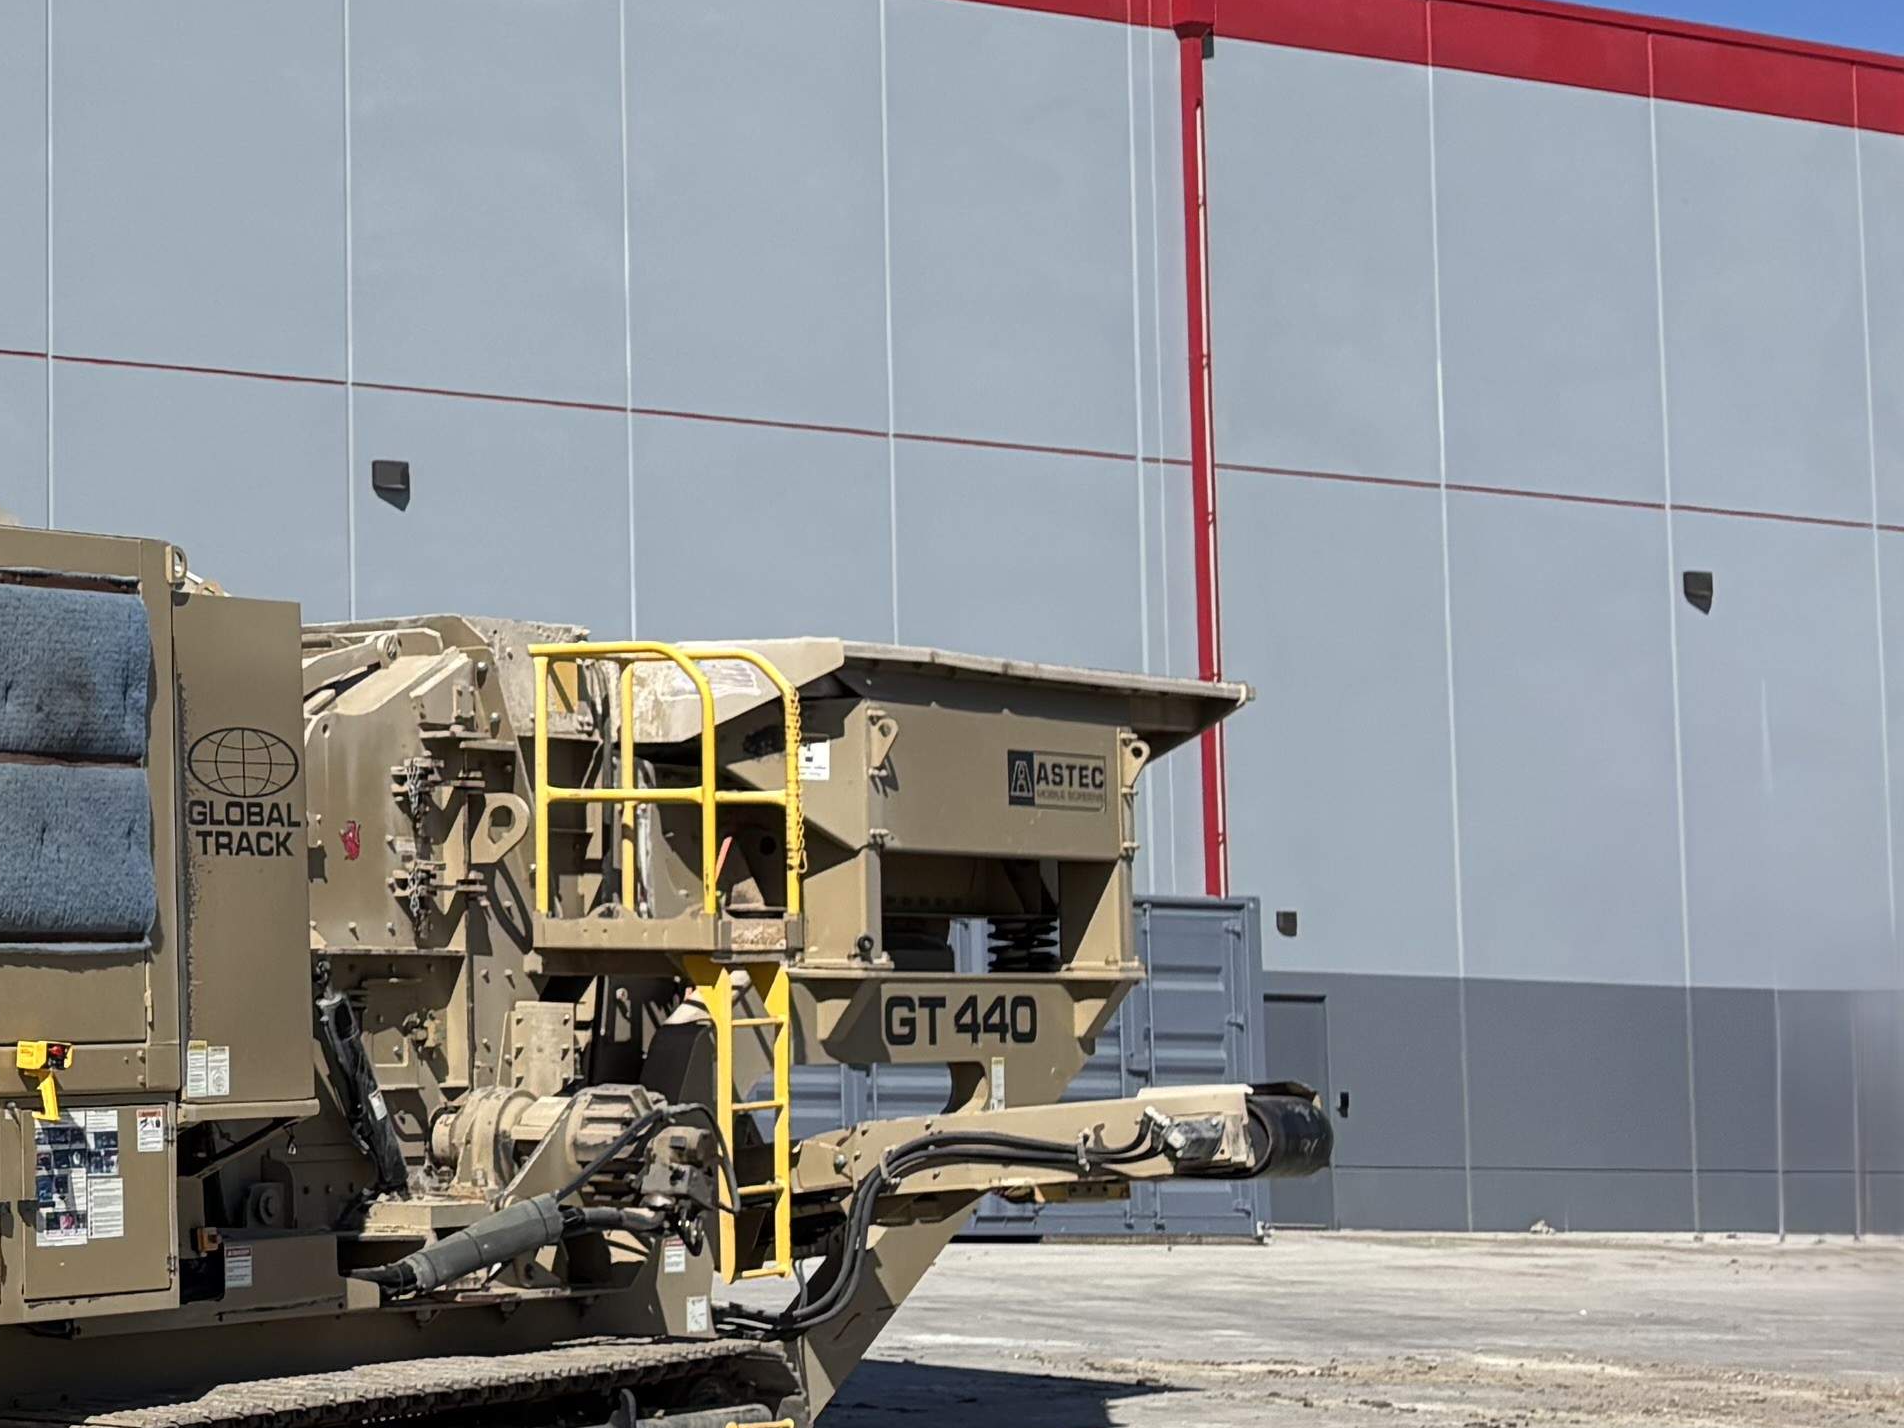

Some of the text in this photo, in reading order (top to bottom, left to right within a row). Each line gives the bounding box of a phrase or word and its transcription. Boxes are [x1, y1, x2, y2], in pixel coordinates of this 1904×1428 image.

[1036, 761, 1104, 789] ASTEC
[188, 800, 301, 828] GLOBAL
[195, 830, 294, 857] TRACK
[885, 994, 1038, 1045] GT 440
